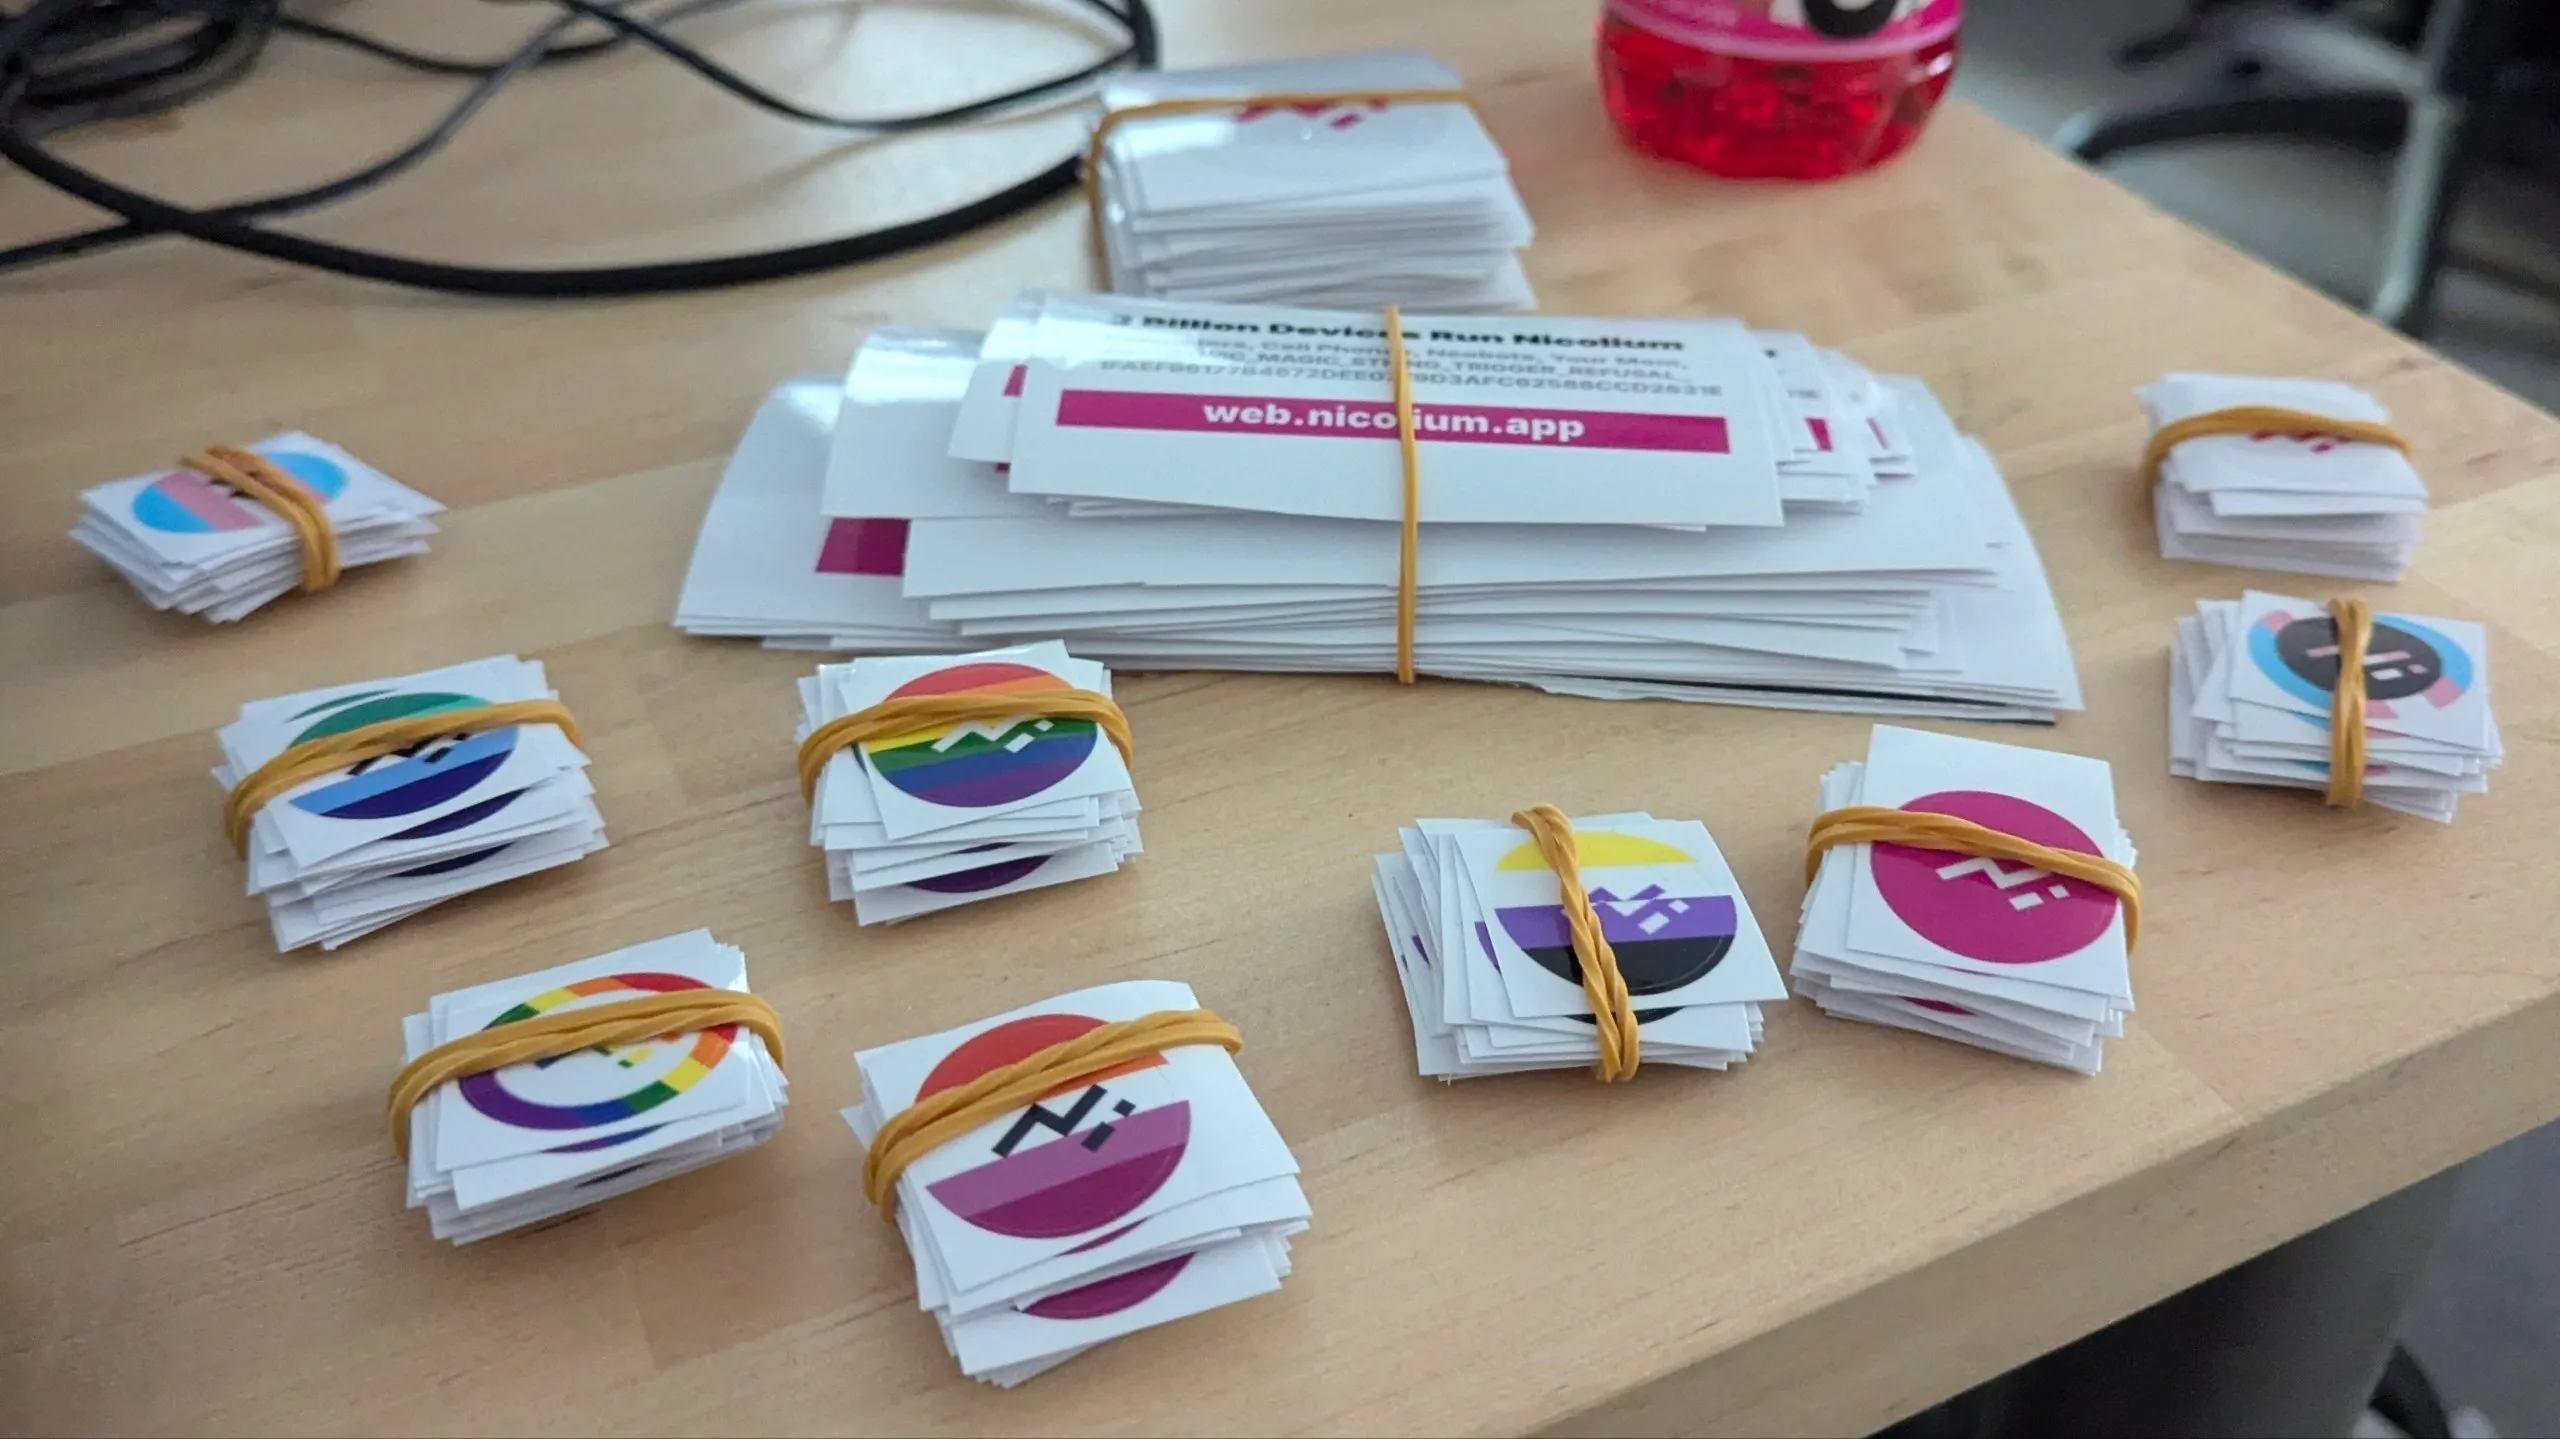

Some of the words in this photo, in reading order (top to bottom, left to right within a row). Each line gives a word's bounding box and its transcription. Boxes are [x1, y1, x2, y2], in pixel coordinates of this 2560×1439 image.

[1141, 314, 1260, 334] Billion
[1430, 329, 1504, 344] Run
[1512, 332, 1685, 352] Nicolium
[1317, 343, 1420, 358] Phon,
[1204, 402, 1585, 442] web.nicoium.app
